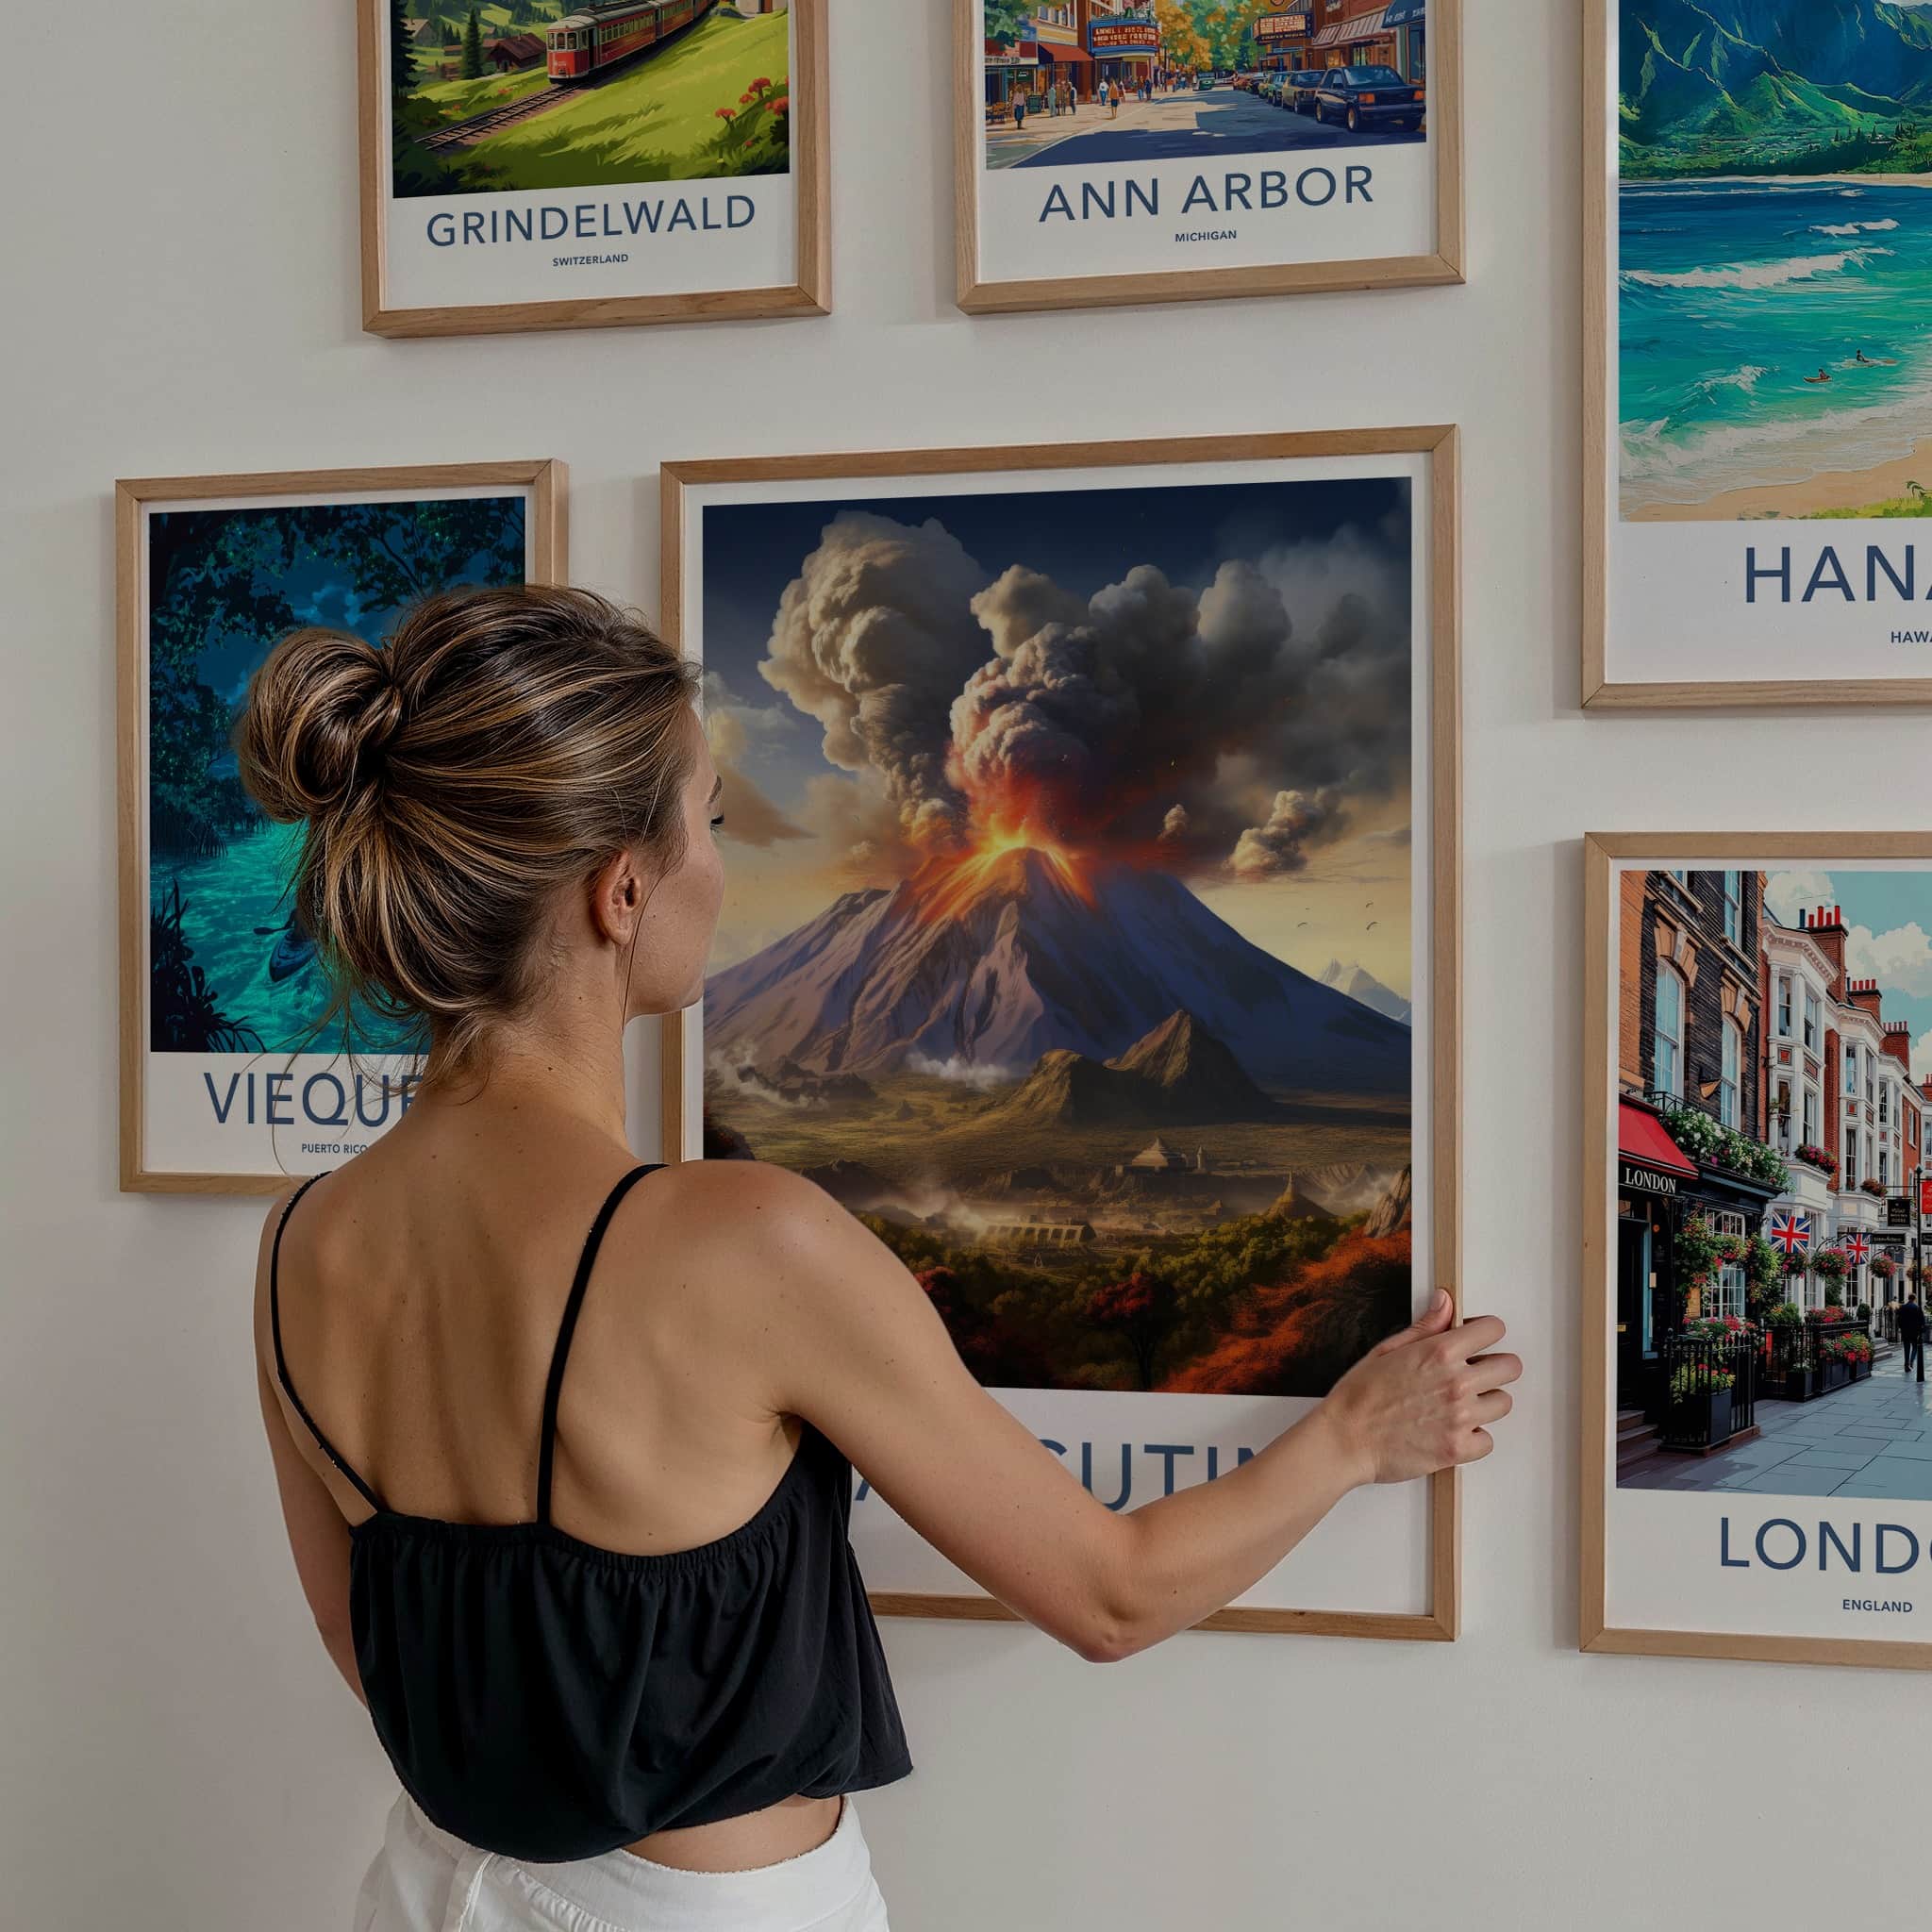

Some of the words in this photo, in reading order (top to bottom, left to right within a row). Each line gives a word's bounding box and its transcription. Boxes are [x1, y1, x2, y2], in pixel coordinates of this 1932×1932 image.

[1039, 177, 1159, 223] ANN
[1181, 165, 1374, 214] ARBOR
[426, 194, 756, 247] GRINDELWALD
[1174, 229, 1238, 242] MICHIGAN
[552, 253, 629, 267] SWITZERLAND
[1746, 544, 1932, 603] HAN
[1890, 630, 1932, 643] HAW
[301, 1143, 341, 1154] PUERTO
[343, 1143, 369, 1155] RICO
[1624, 1167, 1676, 1194] LONDON
[1721, 1516, 1932, 1574] LOND
[1842, 1598, 1913, 1613] ENGLAND
